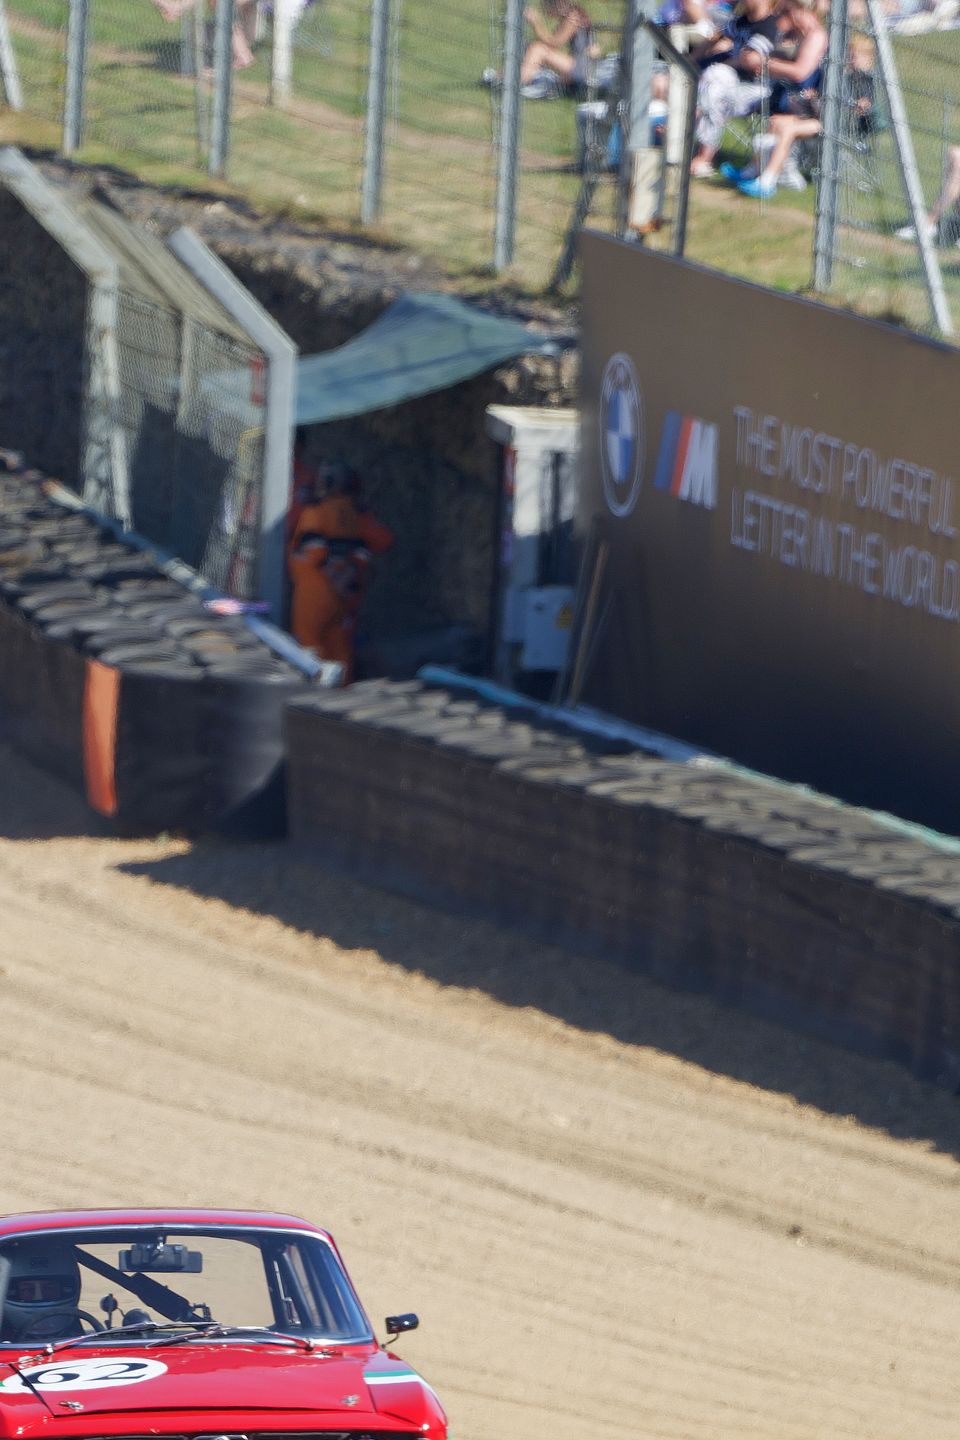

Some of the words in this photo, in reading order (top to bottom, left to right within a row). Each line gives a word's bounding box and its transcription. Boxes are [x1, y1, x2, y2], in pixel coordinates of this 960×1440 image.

[734, 405, 779, 476] THE
[779, 423, 843, 494] MOST
[842, 442, 958, 539] POWERFUL
[730, 487, 810, 569] LETTER
[810, 515, 836, 577] IN
[836, 521, 882, 594] THE
[21, 1362, 149, 1387] 62
